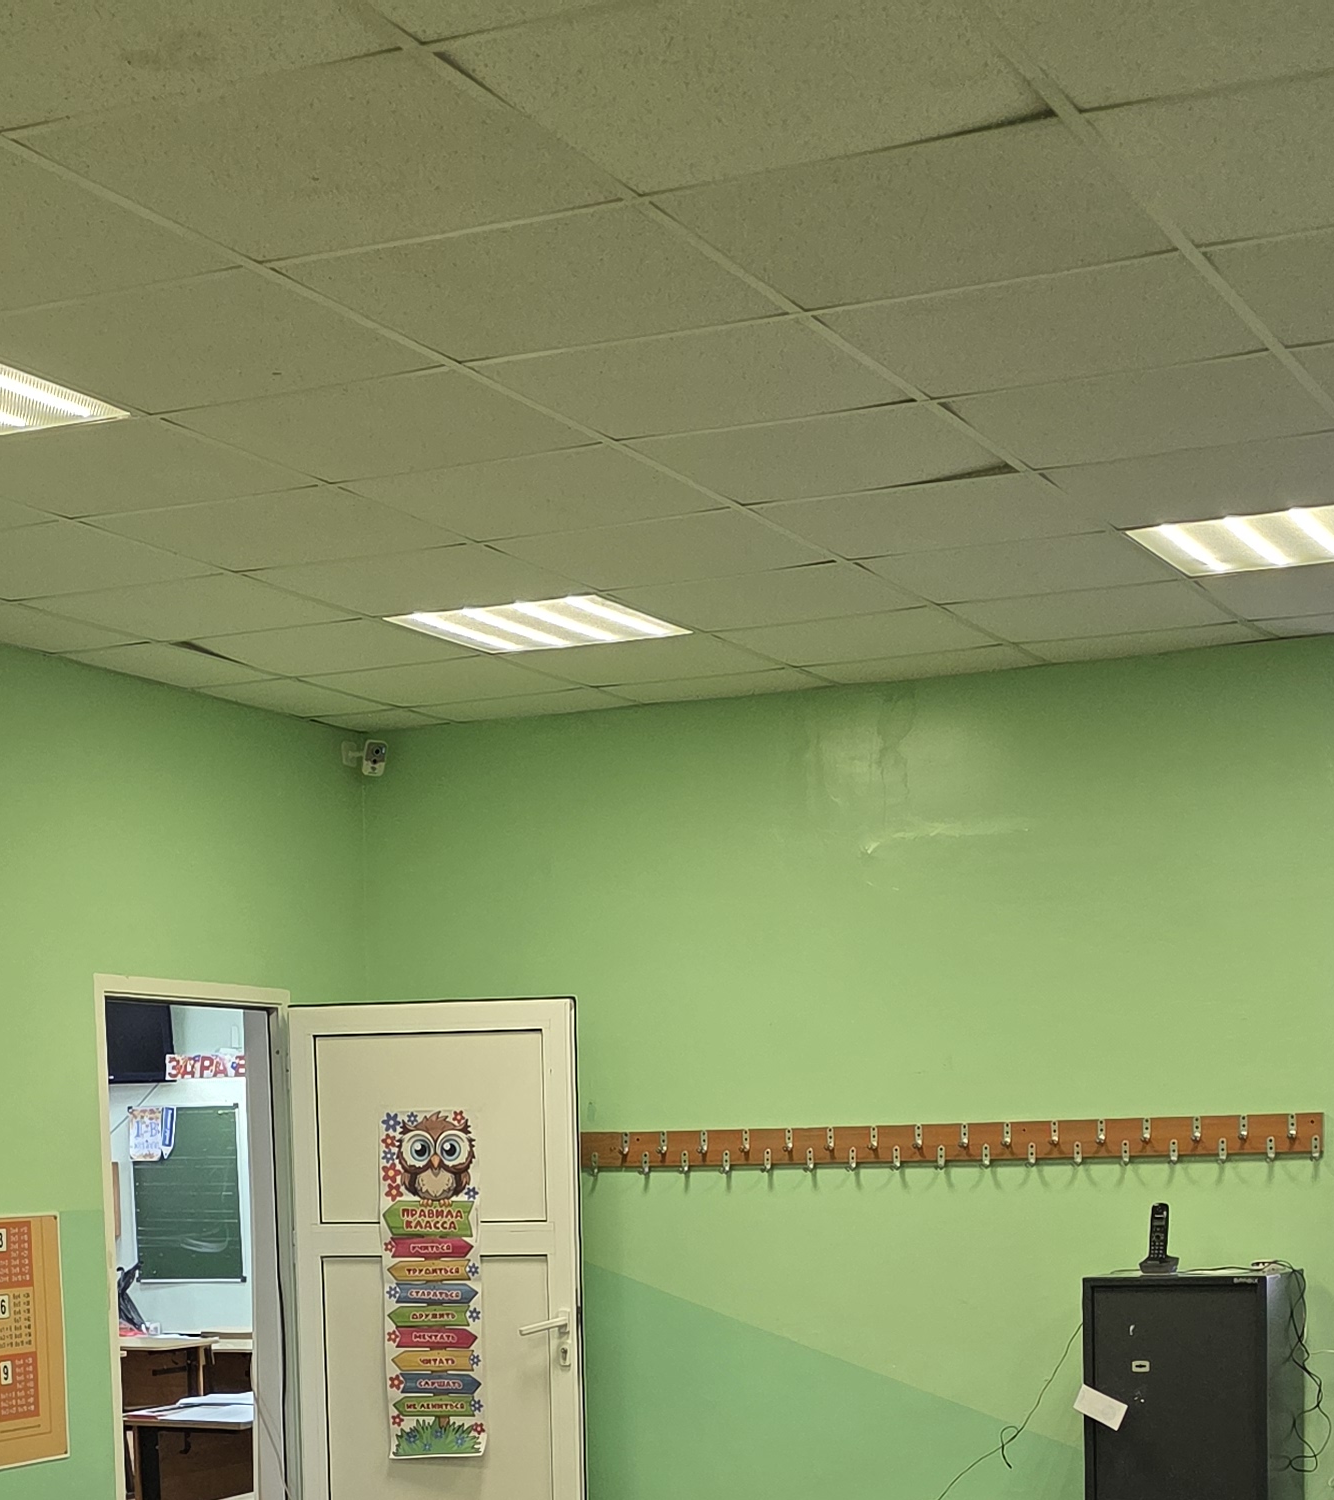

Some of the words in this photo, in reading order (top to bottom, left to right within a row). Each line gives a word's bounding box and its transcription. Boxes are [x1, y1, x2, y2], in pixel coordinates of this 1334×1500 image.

[401, 1207, 464, 1220] ПРАВИЛА
[404, 1219, 458, 1231] КЛАССА
[406, 1266, 461, 1276] ТРУДИТЬСЯ
[408, 1289, 461, 1300] СТАРАТЬСЯ
[0, 1299, 7, 1315] 6
[2, 1364, 9, 1381] 9
